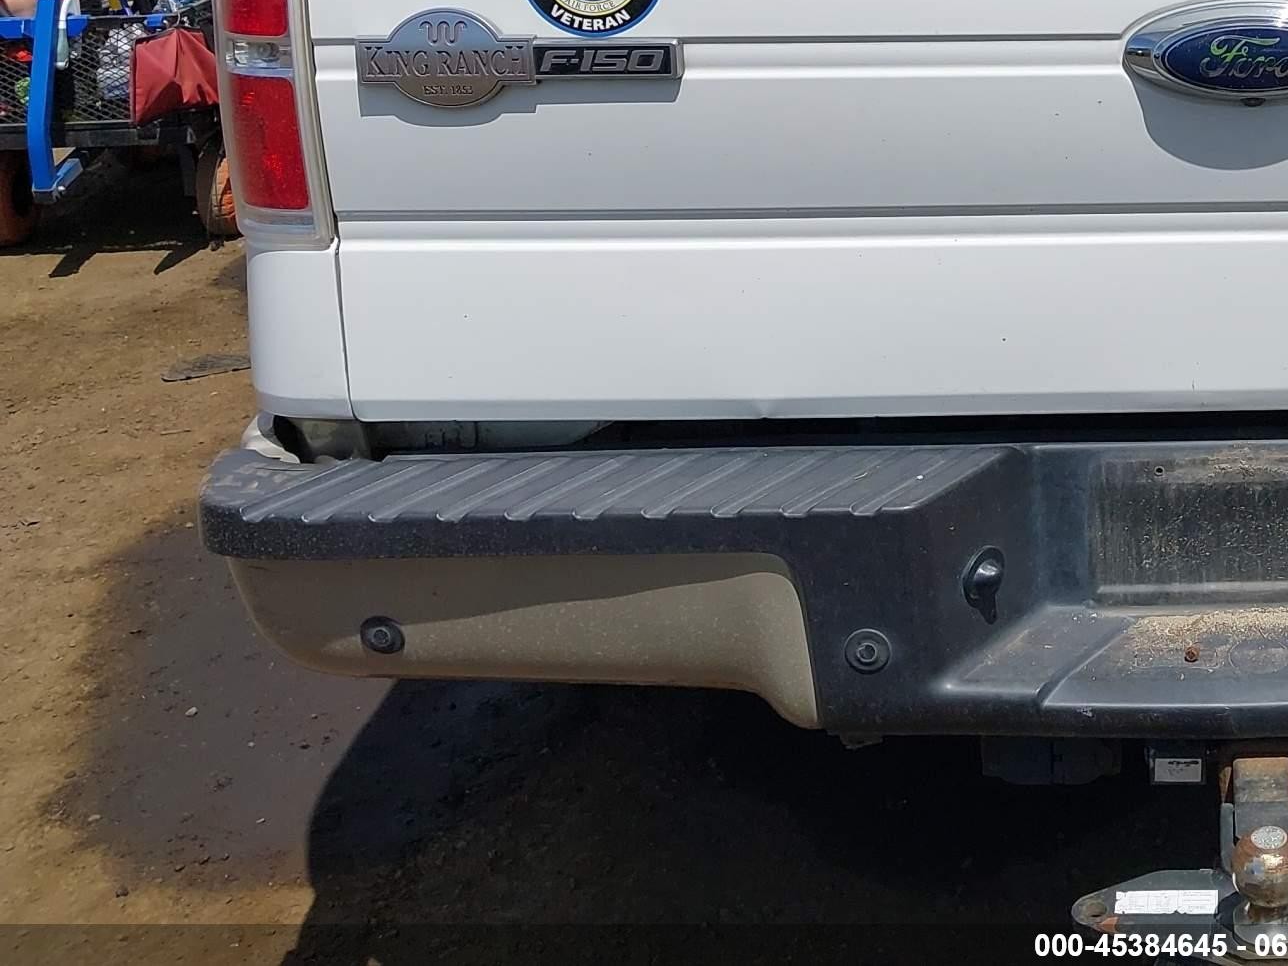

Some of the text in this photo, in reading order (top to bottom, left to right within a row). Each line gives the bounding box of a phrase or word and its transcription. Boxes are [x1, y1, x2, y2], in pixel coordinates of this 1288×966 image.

[550, 4, 631, 31] VETERAN
[583, 0, 616, 12] FORCE
[364, 45, 527, 78] KING RANCH
[539, 49, 664, 72] F-150
